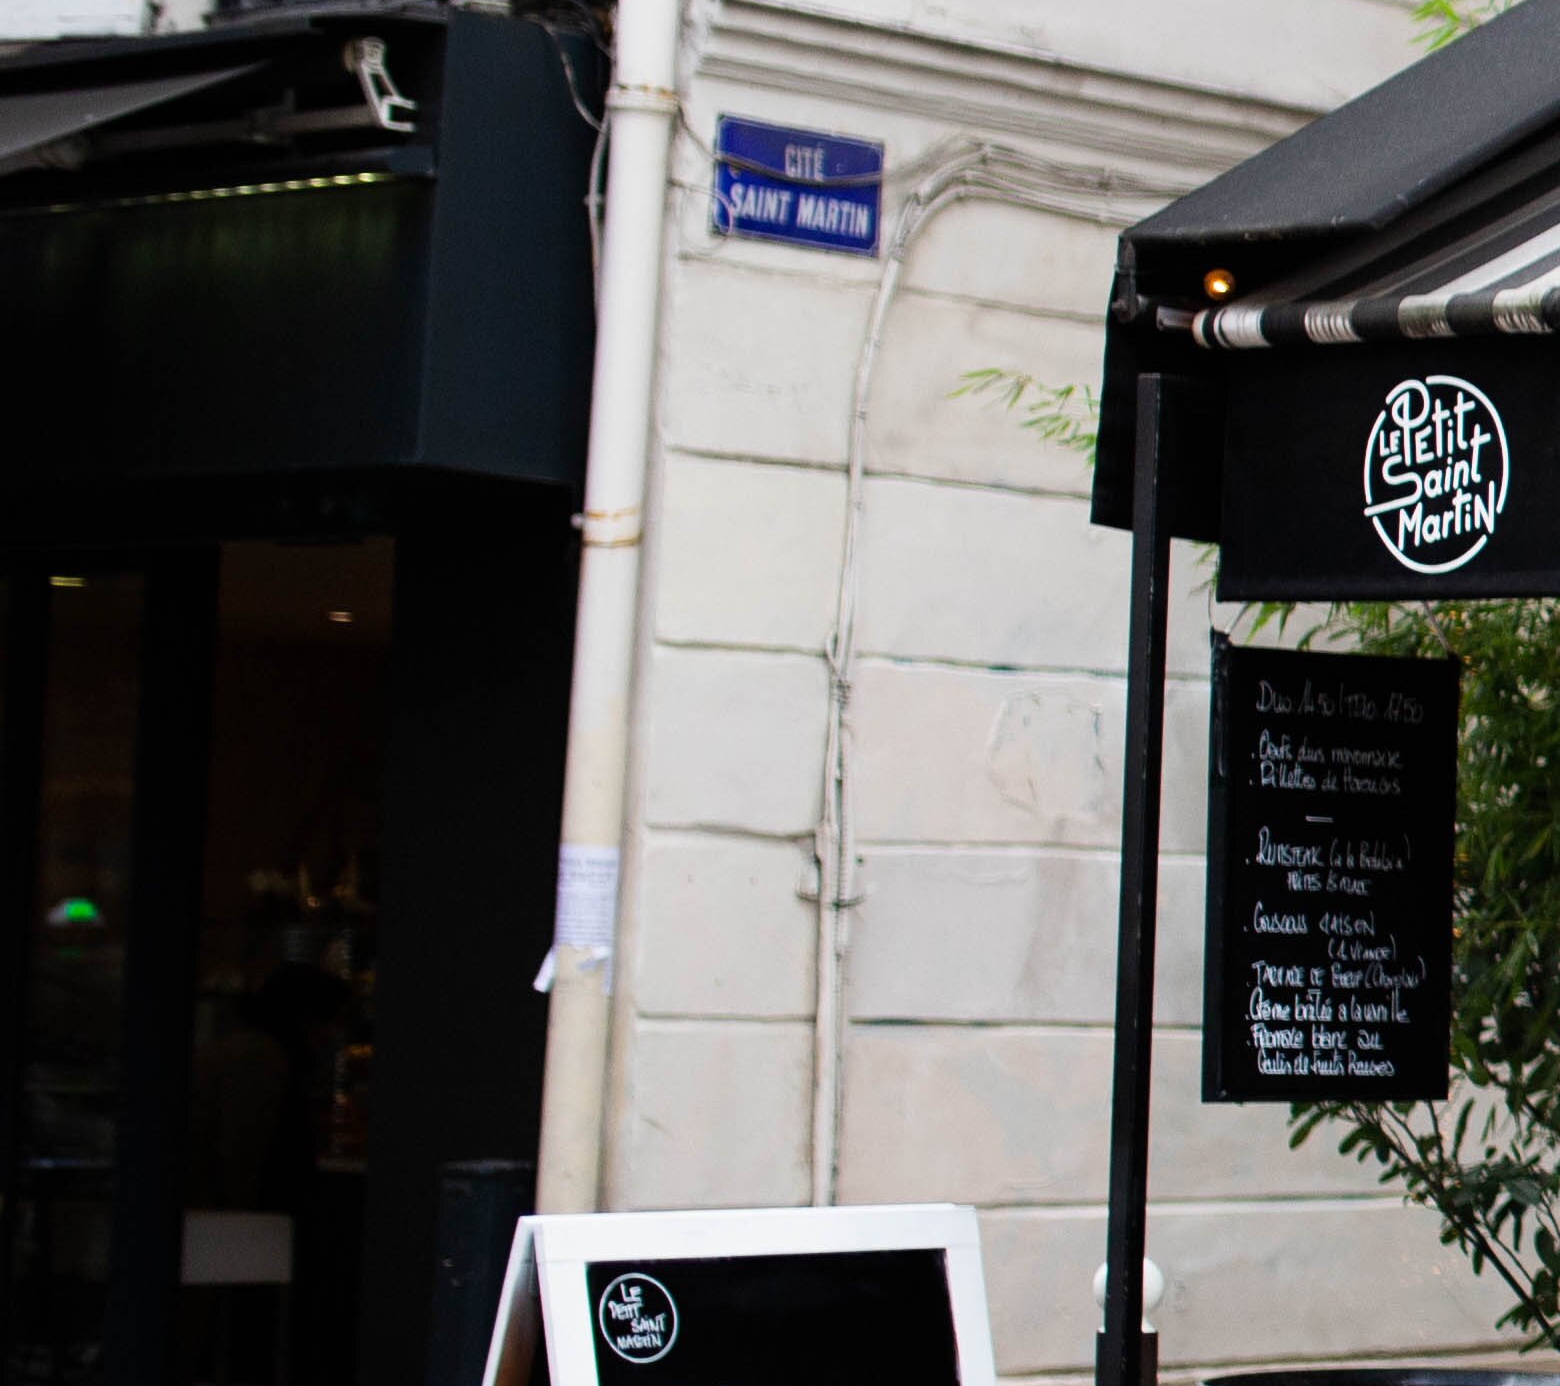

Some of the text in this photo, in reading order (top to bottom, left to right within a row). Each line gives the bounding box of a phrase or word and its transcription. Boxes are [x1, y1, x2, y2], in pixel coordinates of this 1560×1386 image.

[784, 141, 826, 182] CITÉ
[730, 182, 870, 239] SAINT MARTIN
